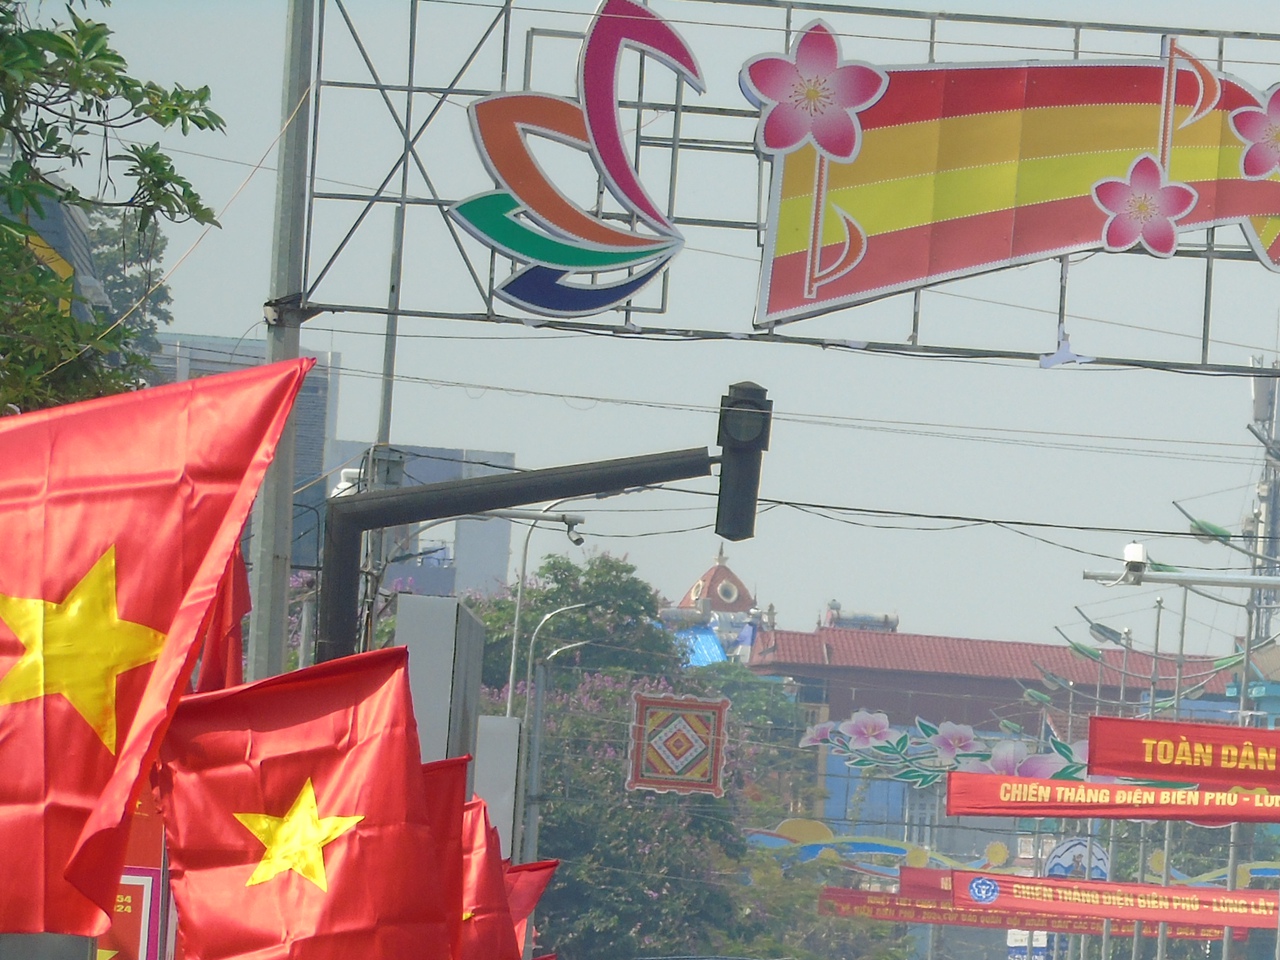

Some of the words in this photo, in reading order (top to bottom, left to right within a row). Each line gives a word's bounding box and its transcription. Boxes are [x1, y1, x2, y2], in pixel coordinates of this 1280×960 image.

[1142, 734, 1212, 767] TOÀN
[1220, 740, 1277, 771] DÂN
[1000, 782, 1051, 802] CHIẾN
[1115, 788, 1155, 807] ĐIỆN
